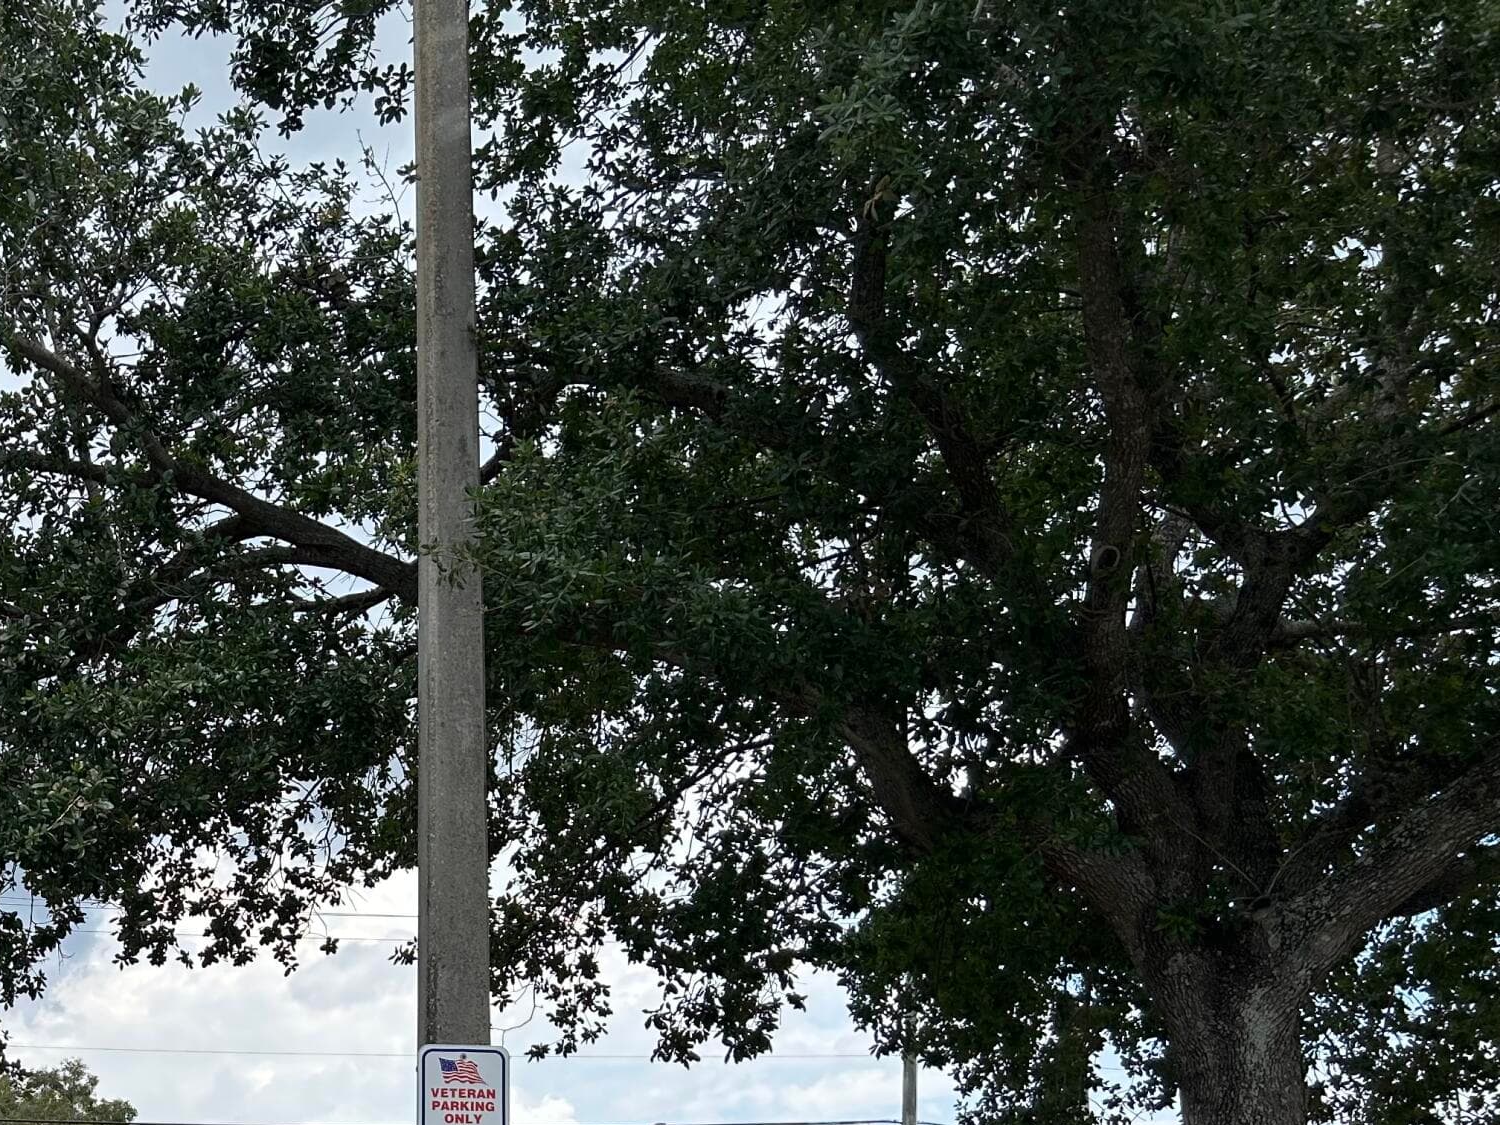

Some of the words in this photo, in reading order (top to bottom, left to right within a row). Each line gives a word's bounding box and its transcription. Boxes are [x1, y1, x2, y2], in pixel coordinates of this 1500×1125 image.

[430, 1087, 496, 1099] VETERAN
[431, 1100, 495, 1112] PARKING
[444, 1113, 483, 1125] ONLY
